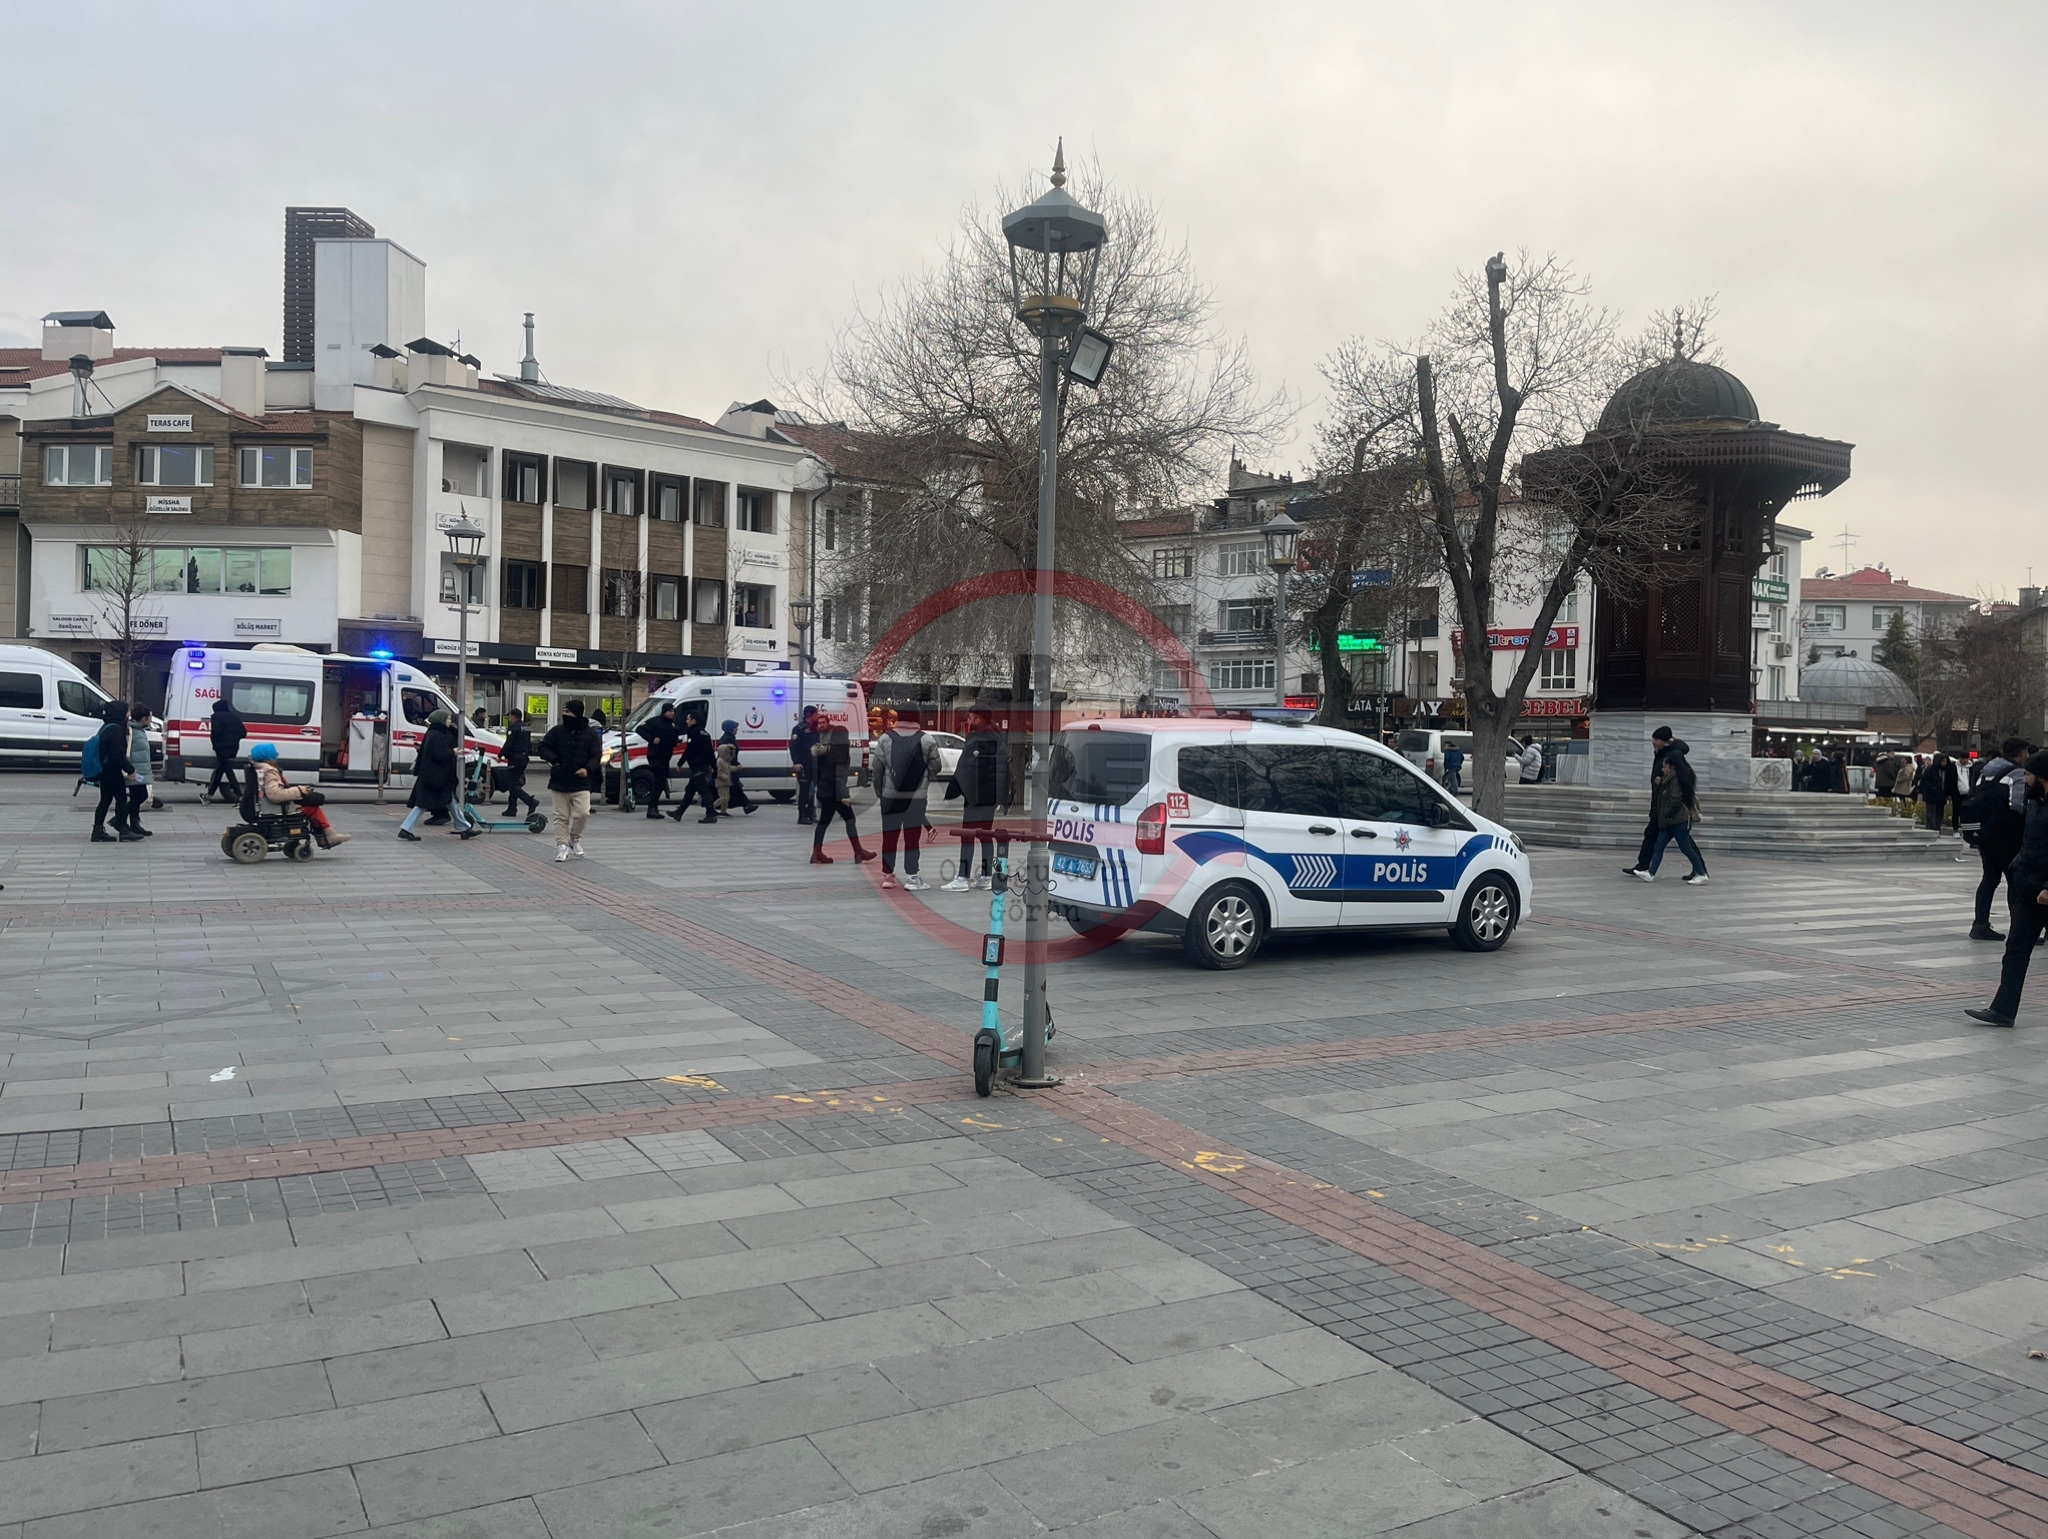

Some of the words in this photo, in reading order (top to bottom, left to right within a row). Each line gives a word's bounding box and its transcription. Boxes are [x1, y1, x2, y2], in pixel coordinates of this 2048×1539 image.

[139, 619, 163, 629] DÖNER
[1170, 795, 1186, 808] 112
[1054, 818, 1095, 843] POLİS
[1058, 856, 1067, 868] 42
[1373, 858, 1428, 883] POLİS
